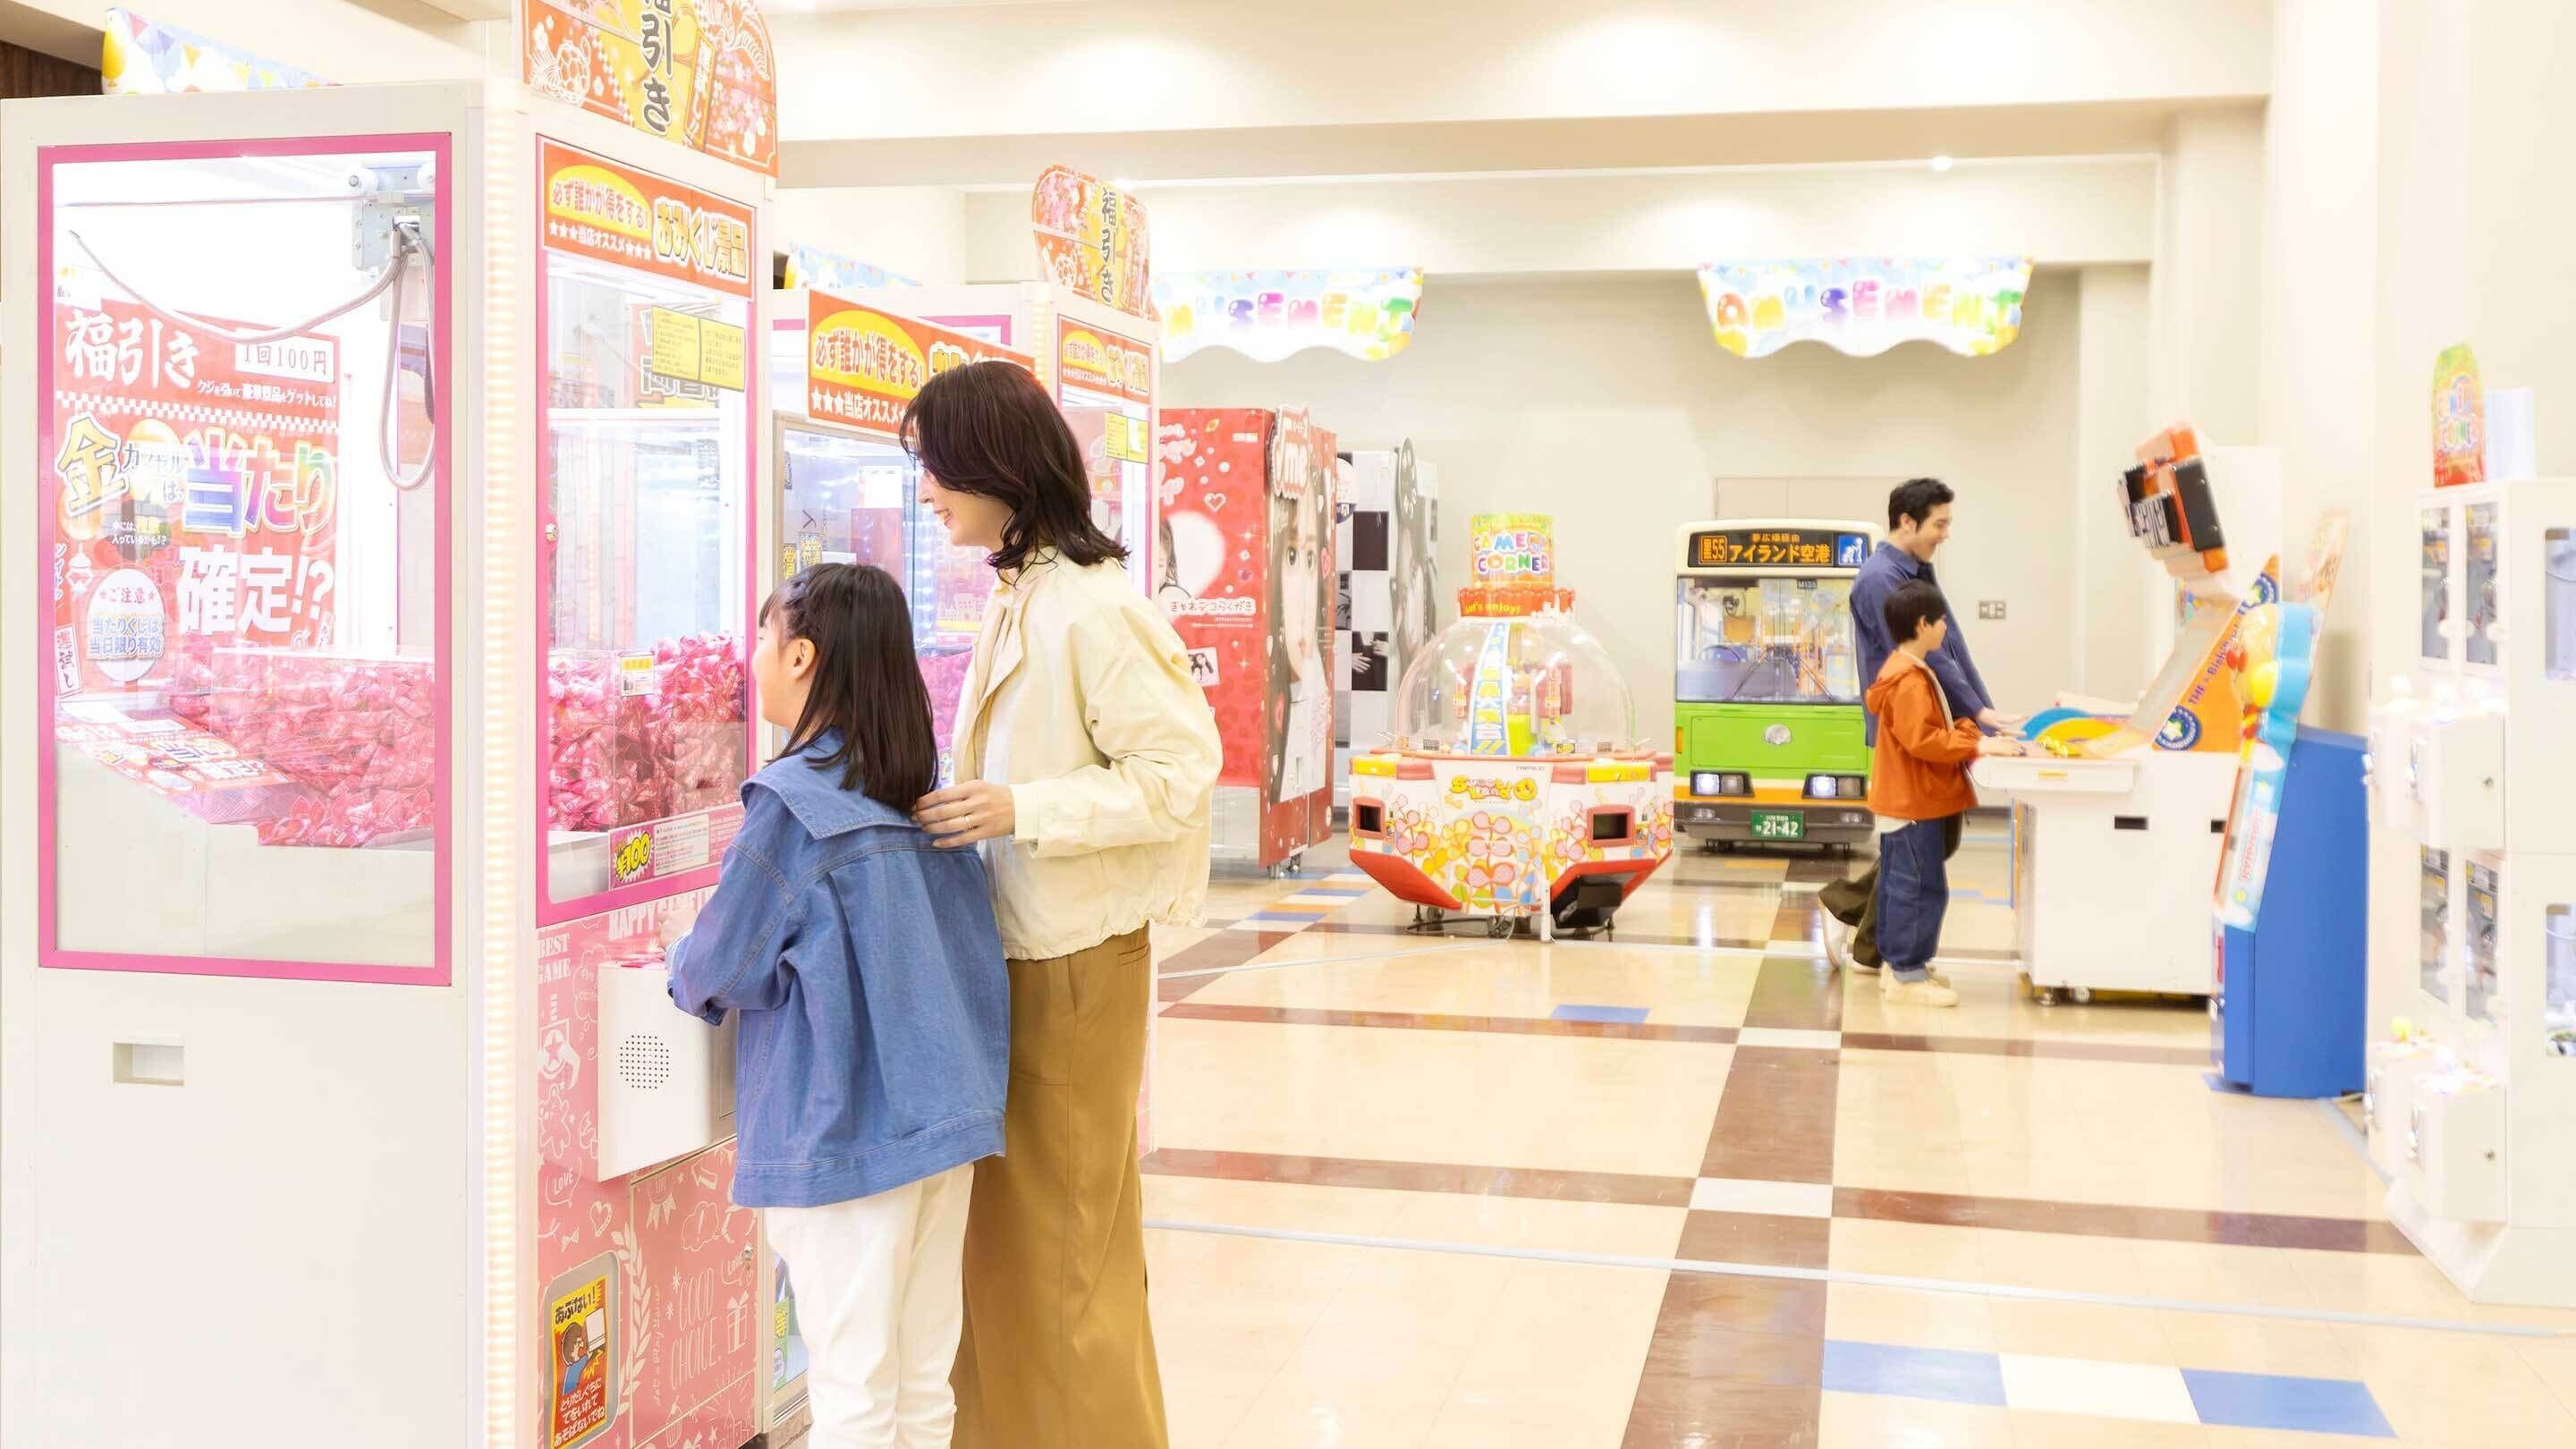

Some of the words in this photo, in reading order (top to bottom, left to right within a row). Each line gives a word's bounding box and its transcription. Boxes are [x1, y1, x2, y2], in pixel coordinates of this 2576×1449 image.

[552, 179, 648, 231] 必ず誰かが得をする!
[578, 225, 626, 251] 当店オススメ
[657, 202, 746, 277] おみくじ景品
[1101, 186, 1117, 304] 福引き
[64, 309, 199, 388] 福引き
[243, 341, 328, 376] 1回100円
[815, 333, 923, 390] 必ず誰かが得をする!
[843, 390, 899, 425] 当店オススメ
[58, 415, 128, 515] 金
[183, 429, 335, 538] 当たり
[1478, 554, 1549, 573] CORNER
[1729, 544, 1831, 564] アイランド空港
[108, 587, 145, 604] ご注意
[176, 544, 335, 637] 確定!?
[89, 636, 163, 656] 当日限り有効
[91, 617, 160, 635] 当たりくじは
[1763, 821, 1799, 836] 21-42
[615, 831, 651, 882] ¥100
[608, 900, 657, 941] HAPPY
[553, 1170, 574, 1196] LOVE
[555, 1286, 597, 1326] あぶない!
[679, 1267, 715, 1332] GOOD
